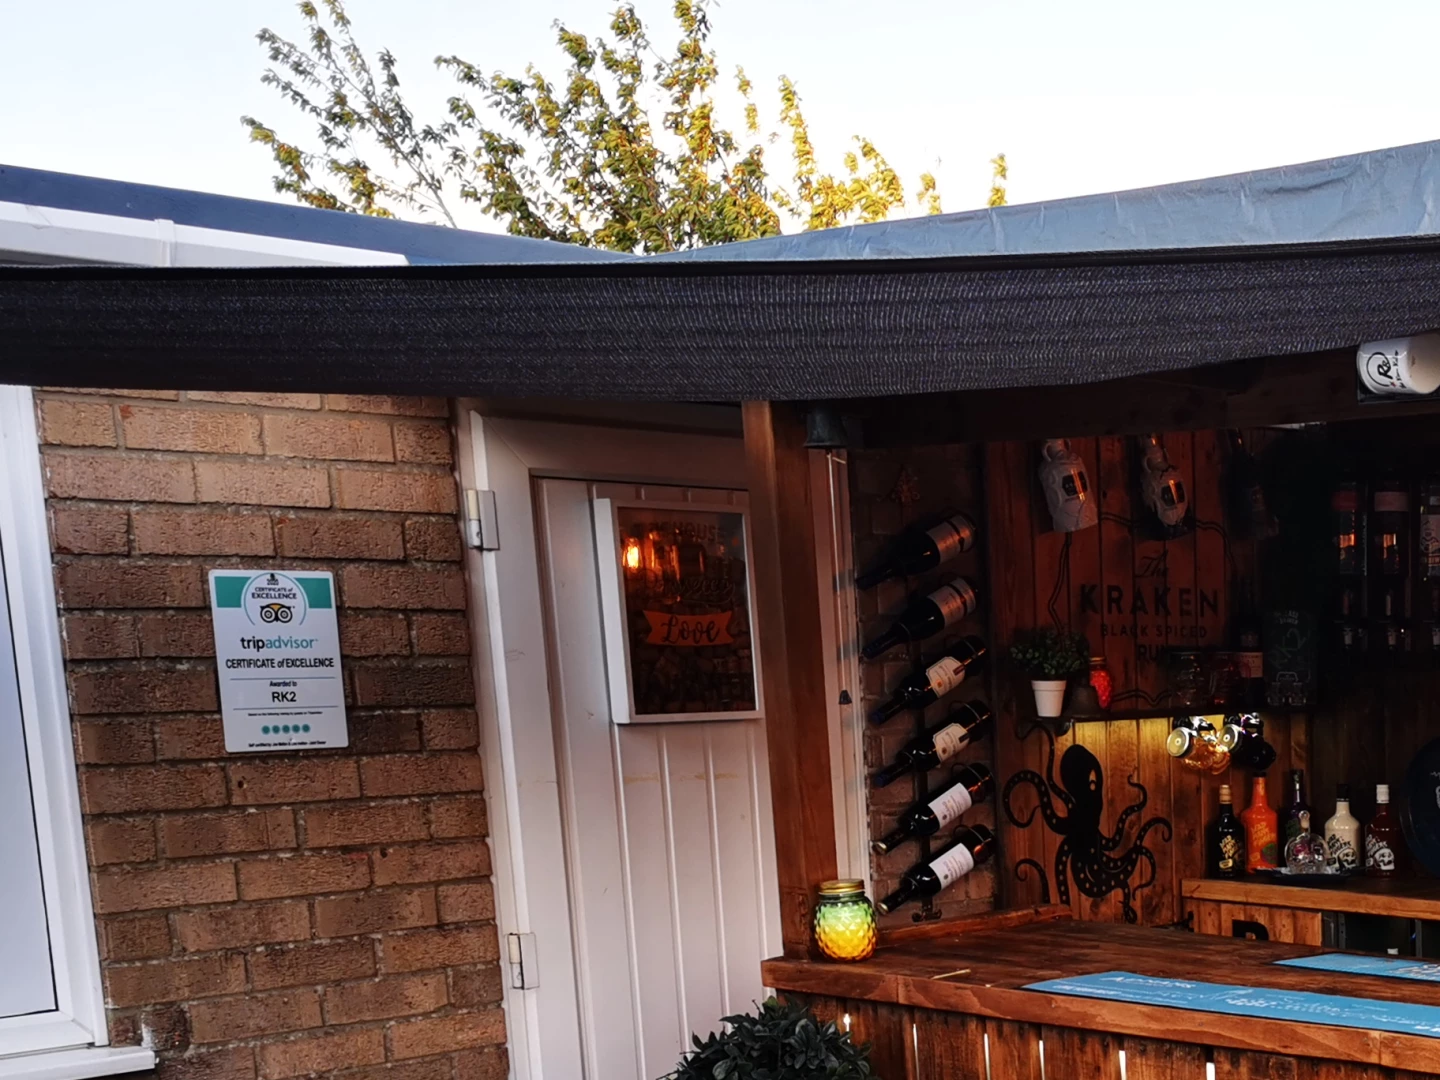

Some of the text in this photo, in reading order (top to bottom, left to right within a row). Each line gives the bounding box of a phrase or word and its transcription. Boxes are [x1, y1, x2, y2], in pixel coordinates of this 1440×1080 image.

[251, 592, 298, 600] EXCELLENCE
[1079, 583, 1219, 618] KRAKEN
[660, 615, 720, 644] Love
[1101, 623, 1208, 639] BLACK SPICED
[240, 635, 315, 652] tripadvisor
[225, 657, 335, 669] CERTIFICATE of EXCELLENCE
[269, 680, 292, 688] Awarded
[271, 690, 297, 703] RK2
